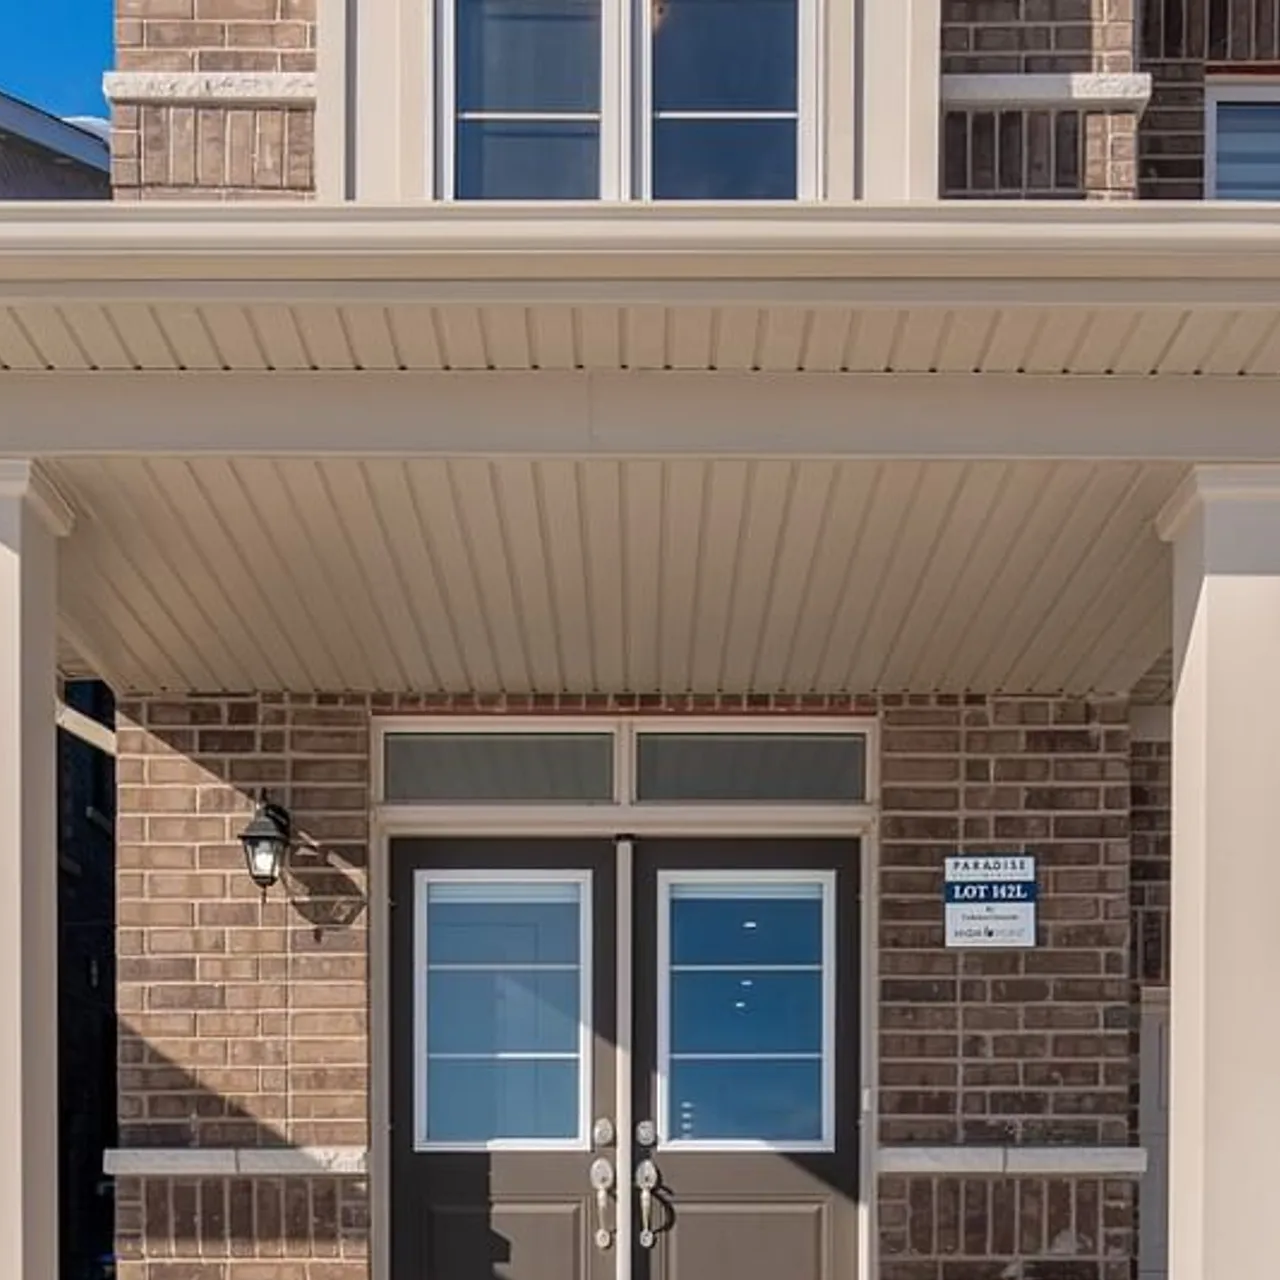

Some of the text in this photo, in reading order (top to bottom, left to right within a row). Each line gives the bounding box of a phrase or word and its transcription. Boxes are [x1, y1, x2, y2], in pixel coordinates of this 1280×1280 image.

[953, 861, 1026, 870] PARADISE
[954, 883, 1028, 899] LOT 142L
